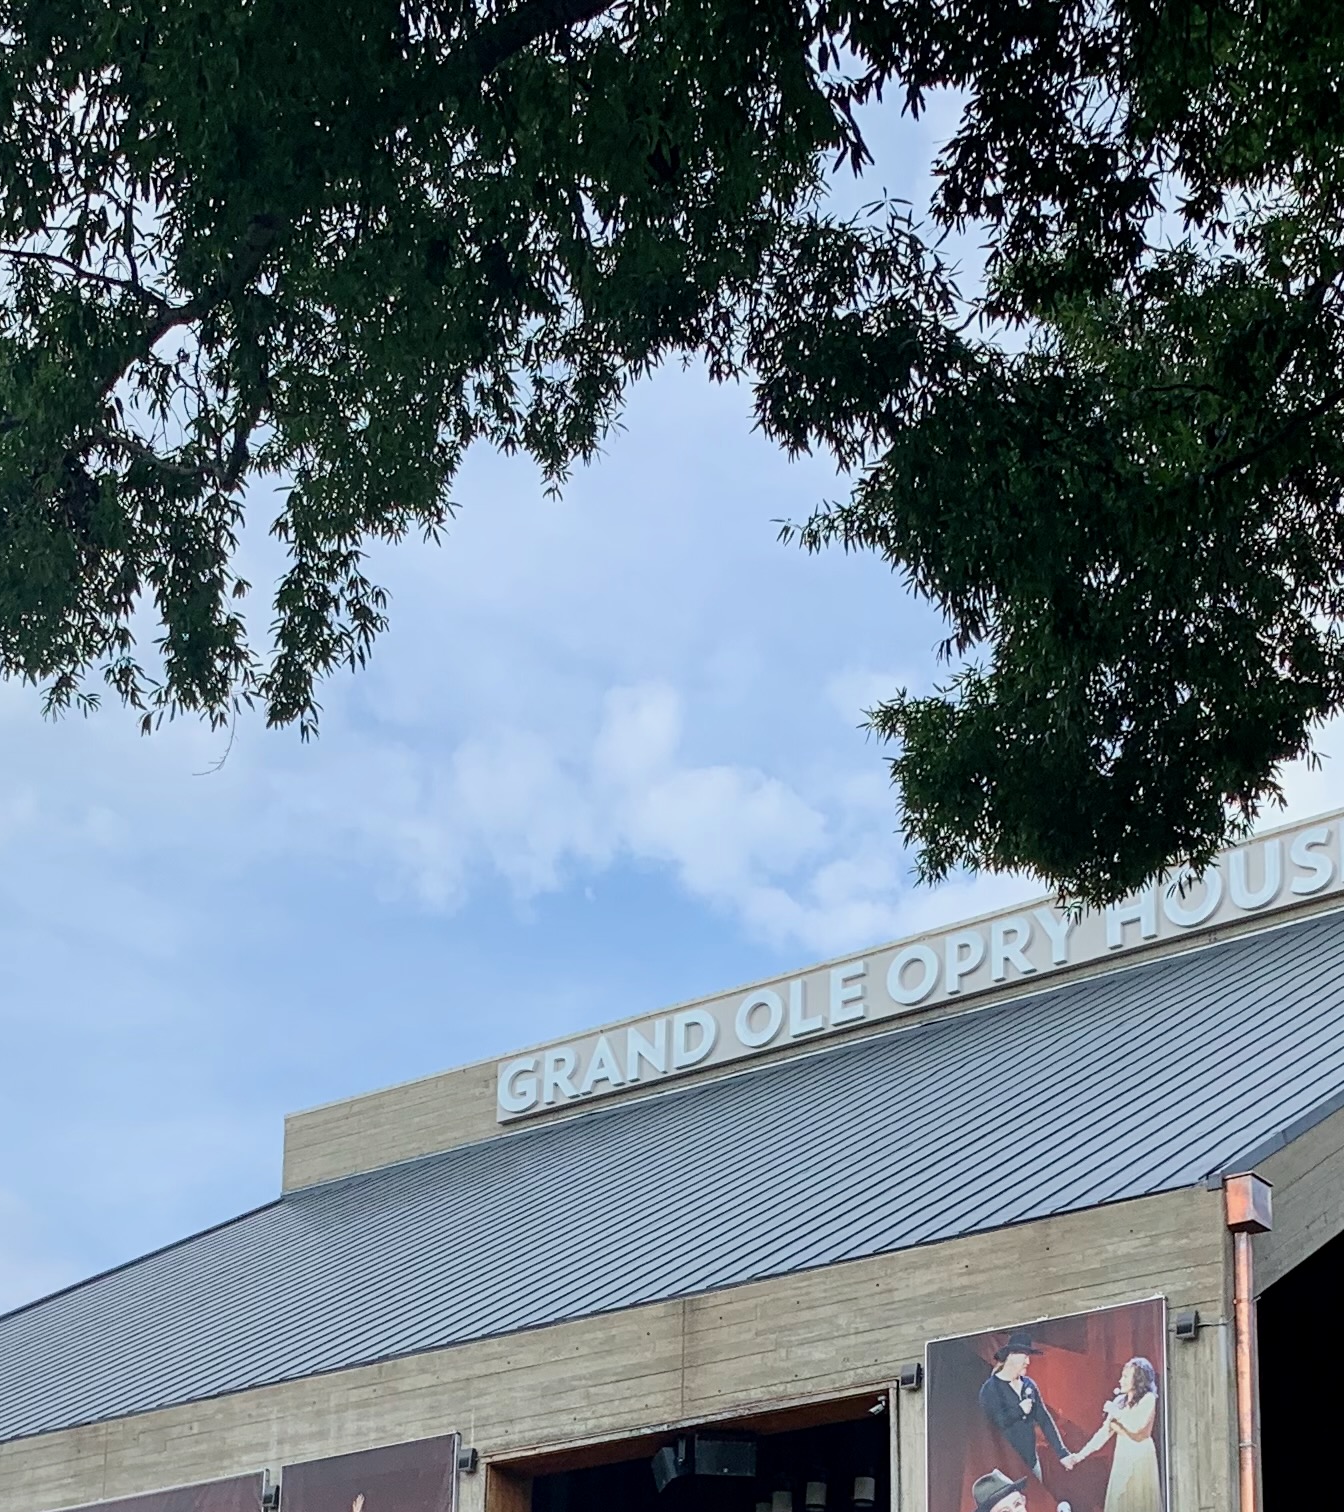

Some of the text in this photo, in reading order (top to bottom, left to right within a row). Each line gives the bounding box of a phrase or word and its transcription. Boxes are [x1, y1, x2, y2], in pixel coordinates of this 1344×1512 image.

[498, 1008, 719, 1113] GRAND
[735, 960, 869, 1048] OLE
[886, 905, 1077, 1005] OPRY
